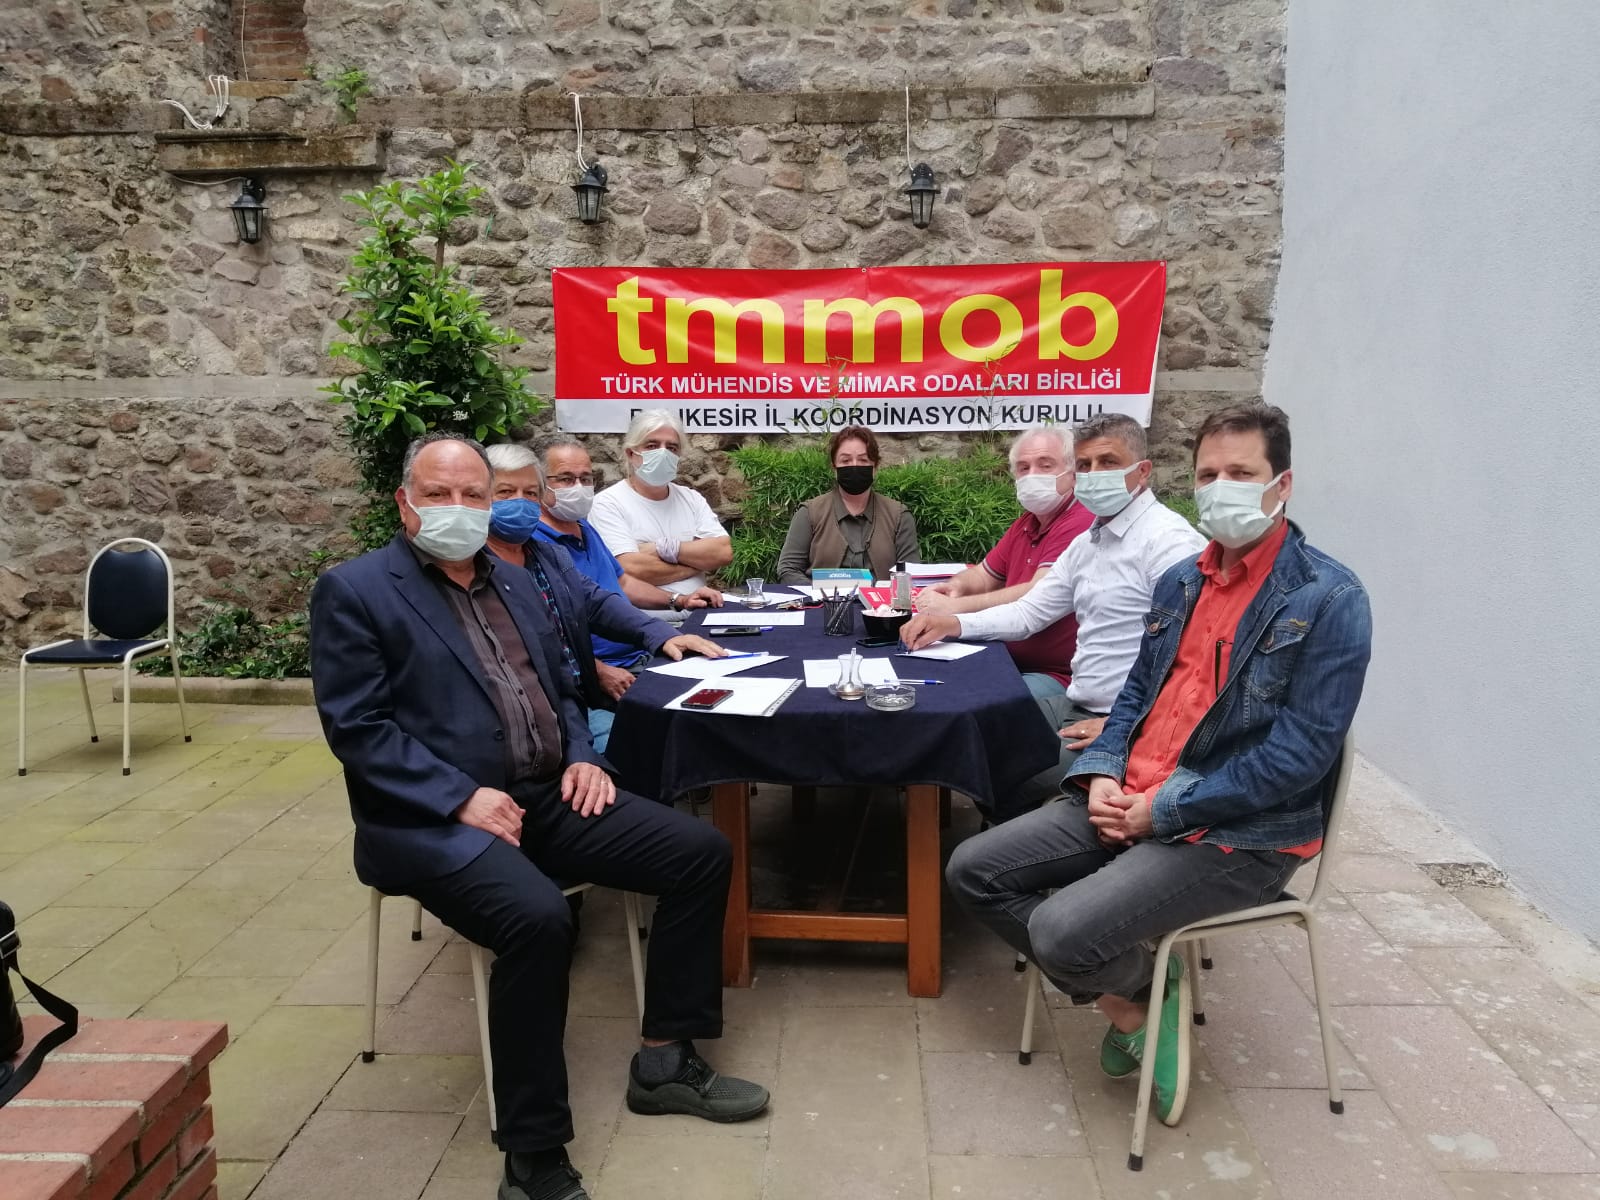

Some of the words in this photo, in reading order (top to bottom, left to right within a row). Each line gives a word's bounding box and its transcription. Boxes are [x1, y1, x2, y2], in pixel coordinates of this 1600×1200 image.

[607, 269, 1119, 365] tmmob
[601, 373, 664, 393] TÜRK
[671, 373, 793, 393] MÜHENDİS
[800, 376, 831, 393] VE
[839, 372, 916, 393] MİMAR
[923, 373, 1029, 392] ODALARI
[1036, 368, 1121, 390] BİRLİĞİ
[766, 404, 786, 426] İL
[793, 402, 992, 427] KOORDİNASYON
